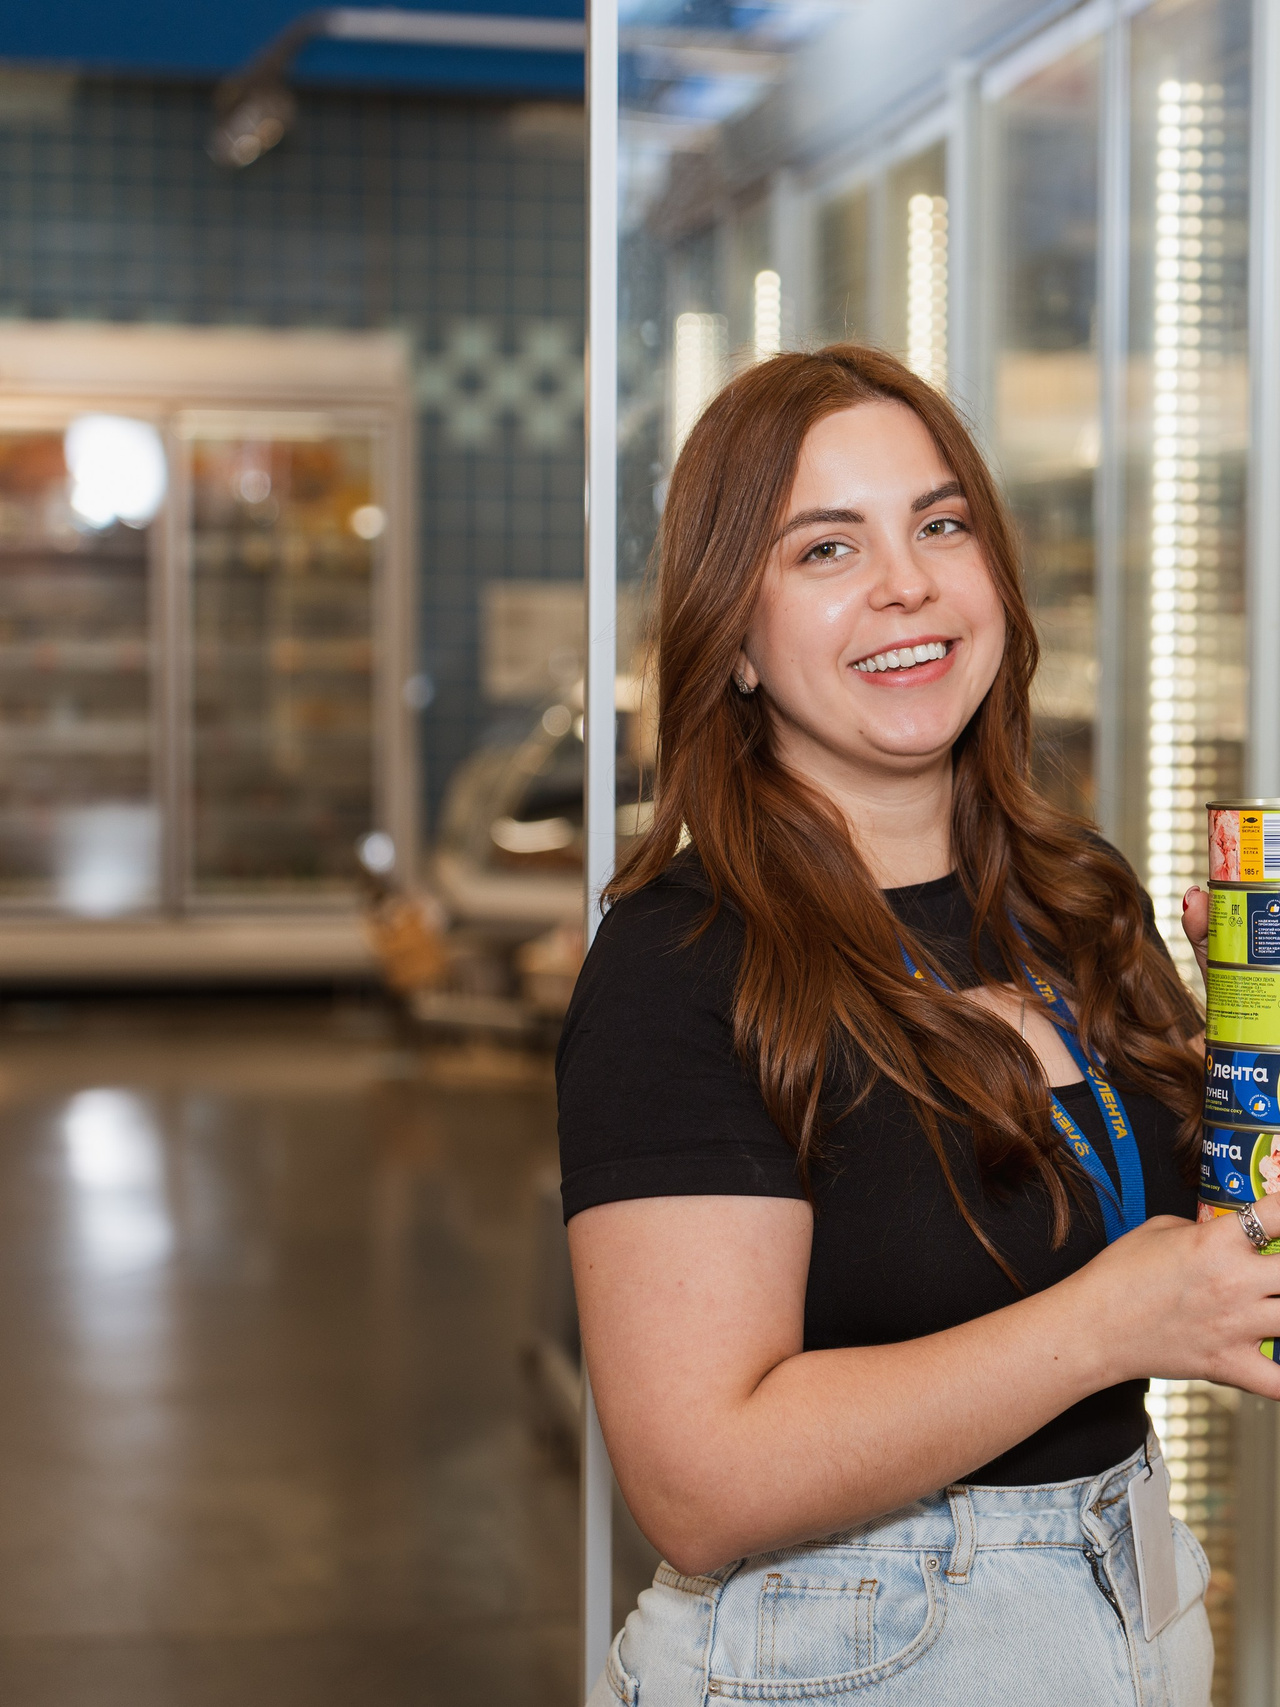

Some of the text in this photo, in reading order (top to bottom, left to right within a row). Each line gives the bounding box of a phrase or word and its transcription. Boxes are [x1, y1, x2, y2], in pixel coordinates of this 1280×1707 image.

[1244, 868, 1255, 876] 185
[1213, 1063, 1269, 1083] лента
[1206, 1087, 1229, 1101] ТУНЕЦ
[1093, 1078, 1128, 1140] ЛЕНТА
[1230, 1107, 1243, 1115] соку
